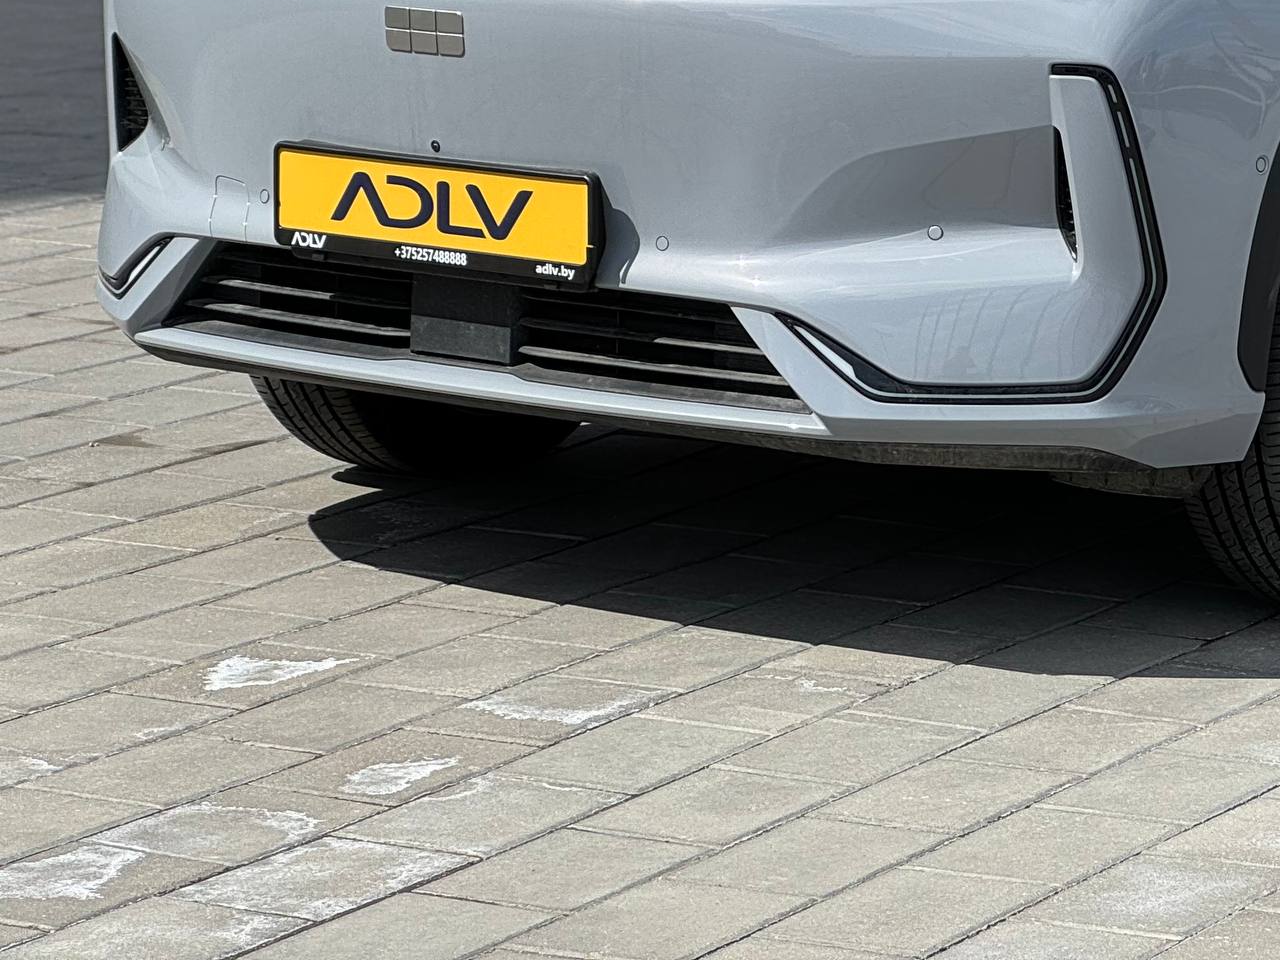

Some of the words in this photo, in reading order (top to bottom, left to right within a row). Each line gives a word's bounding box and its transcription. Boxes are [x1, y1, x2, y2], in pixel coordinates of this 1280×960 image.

[331, 171, 533, 240] ADLV
[291, 231, 326, 248] ADLV
[394, 246, 467, 266] +375257488888
[535, 263, 575, 280] adlv.by
